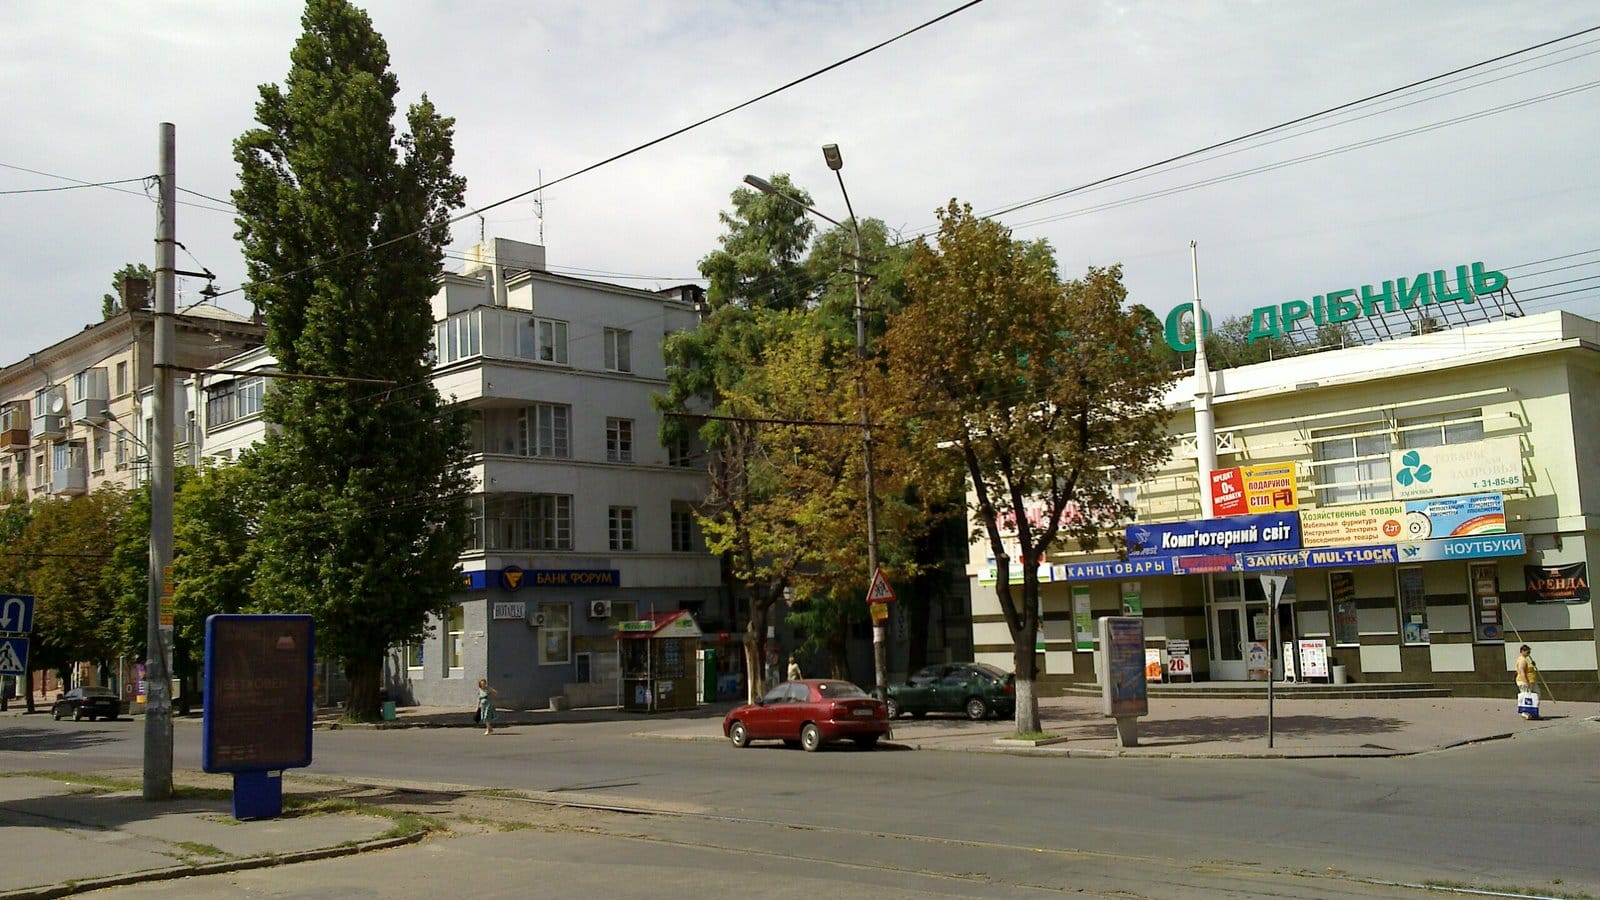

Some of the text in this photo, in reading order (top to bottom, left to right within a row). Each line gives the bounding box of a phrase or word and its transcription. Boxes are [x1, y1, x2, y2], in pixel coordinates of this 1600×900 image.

[1248, 261, 1510, 344] ДРІБНИЦЬ
[1248, 478, 1290, 490] ПОДАРУНОК
[1481, 476, 1520, 488] 31-85-85
[1302, 506, 1402, 520] Хозяйственные товары
[1342, 518, 1377, 527] фурнитура
[1162, 521, 1290, 549] Комп'ютерний світ
[1304, 526, 1378, 537] Инструмент Электрика
[1444, 538, 1522, 555] НОУТБУКИ
[1246, 555, 1298, 567] ЗАМКИ
[537, 573, 612, 584] БАНК ФОРУМ
[1527, 578, 1588, 591] АРЕНДА
